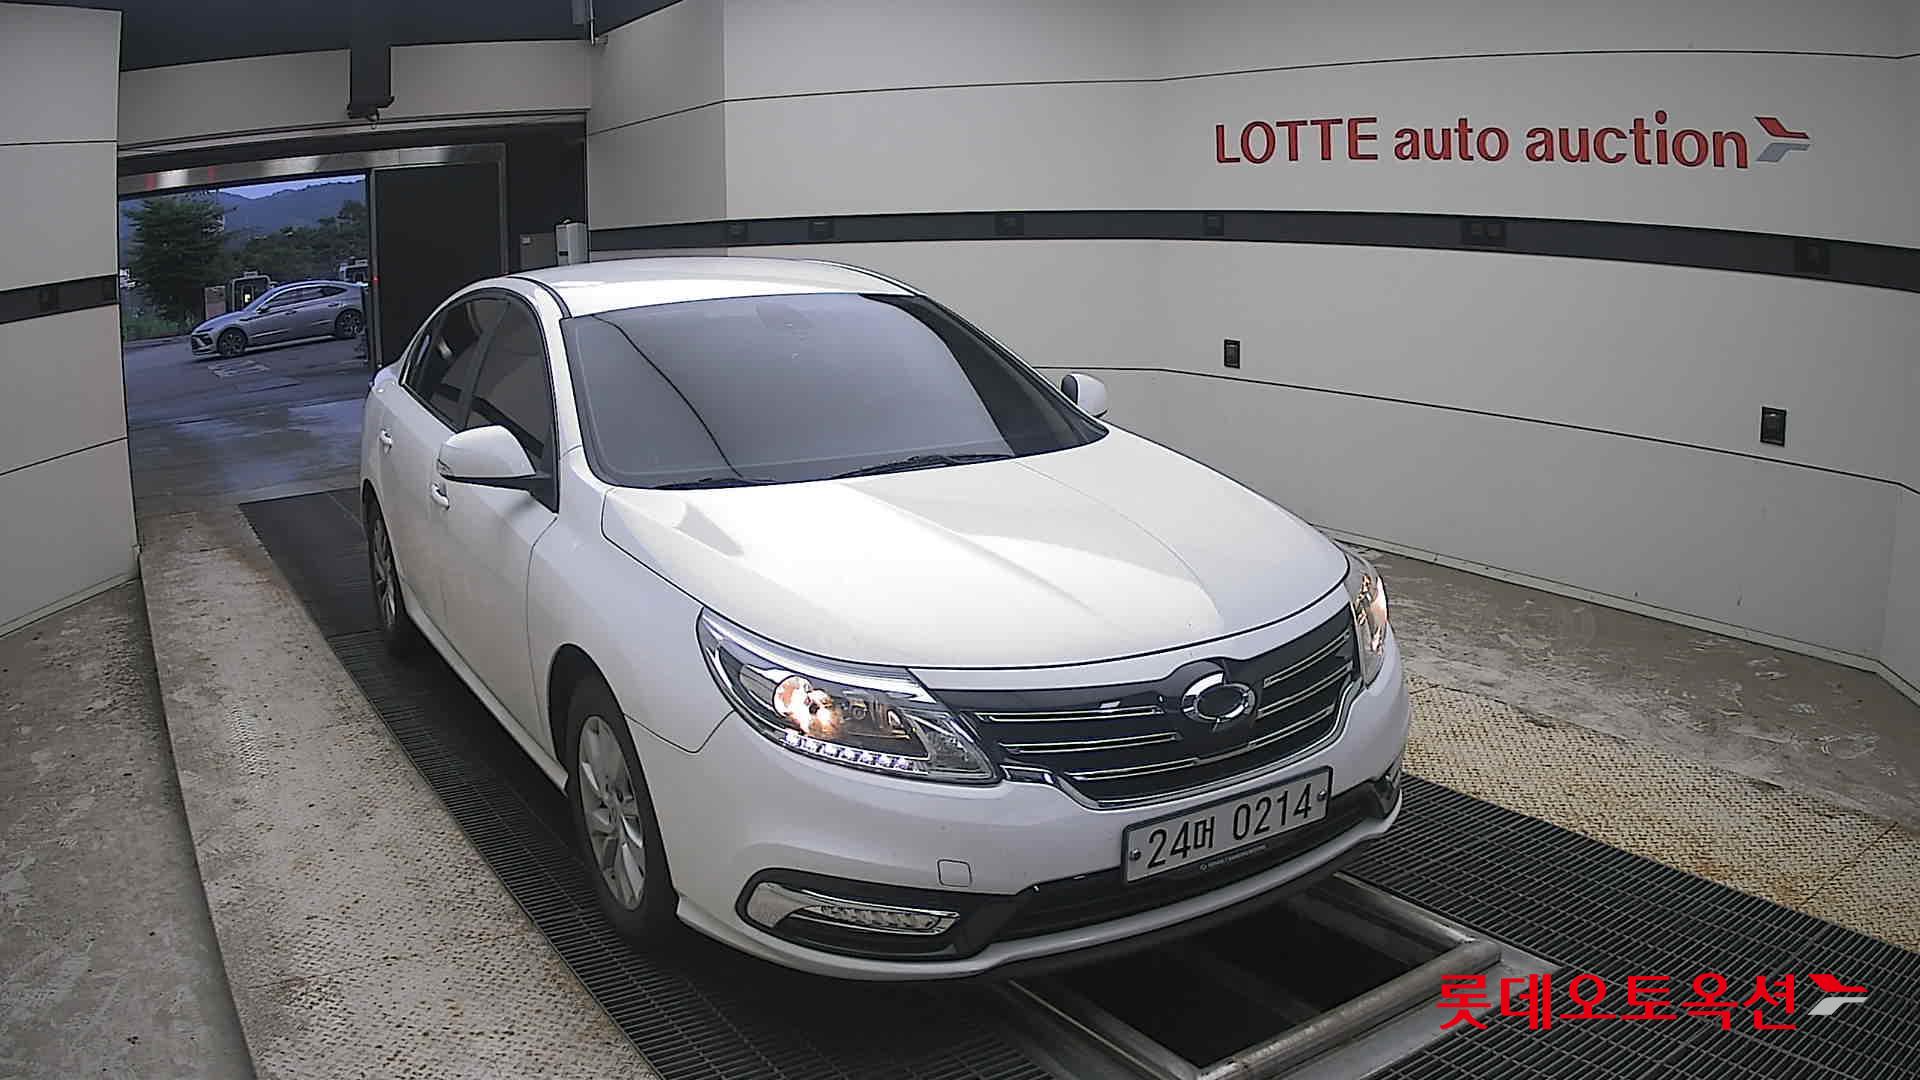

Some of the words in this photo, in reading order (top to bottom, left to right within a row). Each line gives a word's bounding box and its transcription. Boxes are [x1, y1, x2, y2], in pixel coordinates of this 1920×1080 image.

[1215, 117, 1378, 164] LOTTE
[1394, 117, 1509, 161] auto
[1525, 110, 1748, 169] auction
[1147, 816, 1215, 869] 24머
[1232, 783, 1312, 841] 0214
